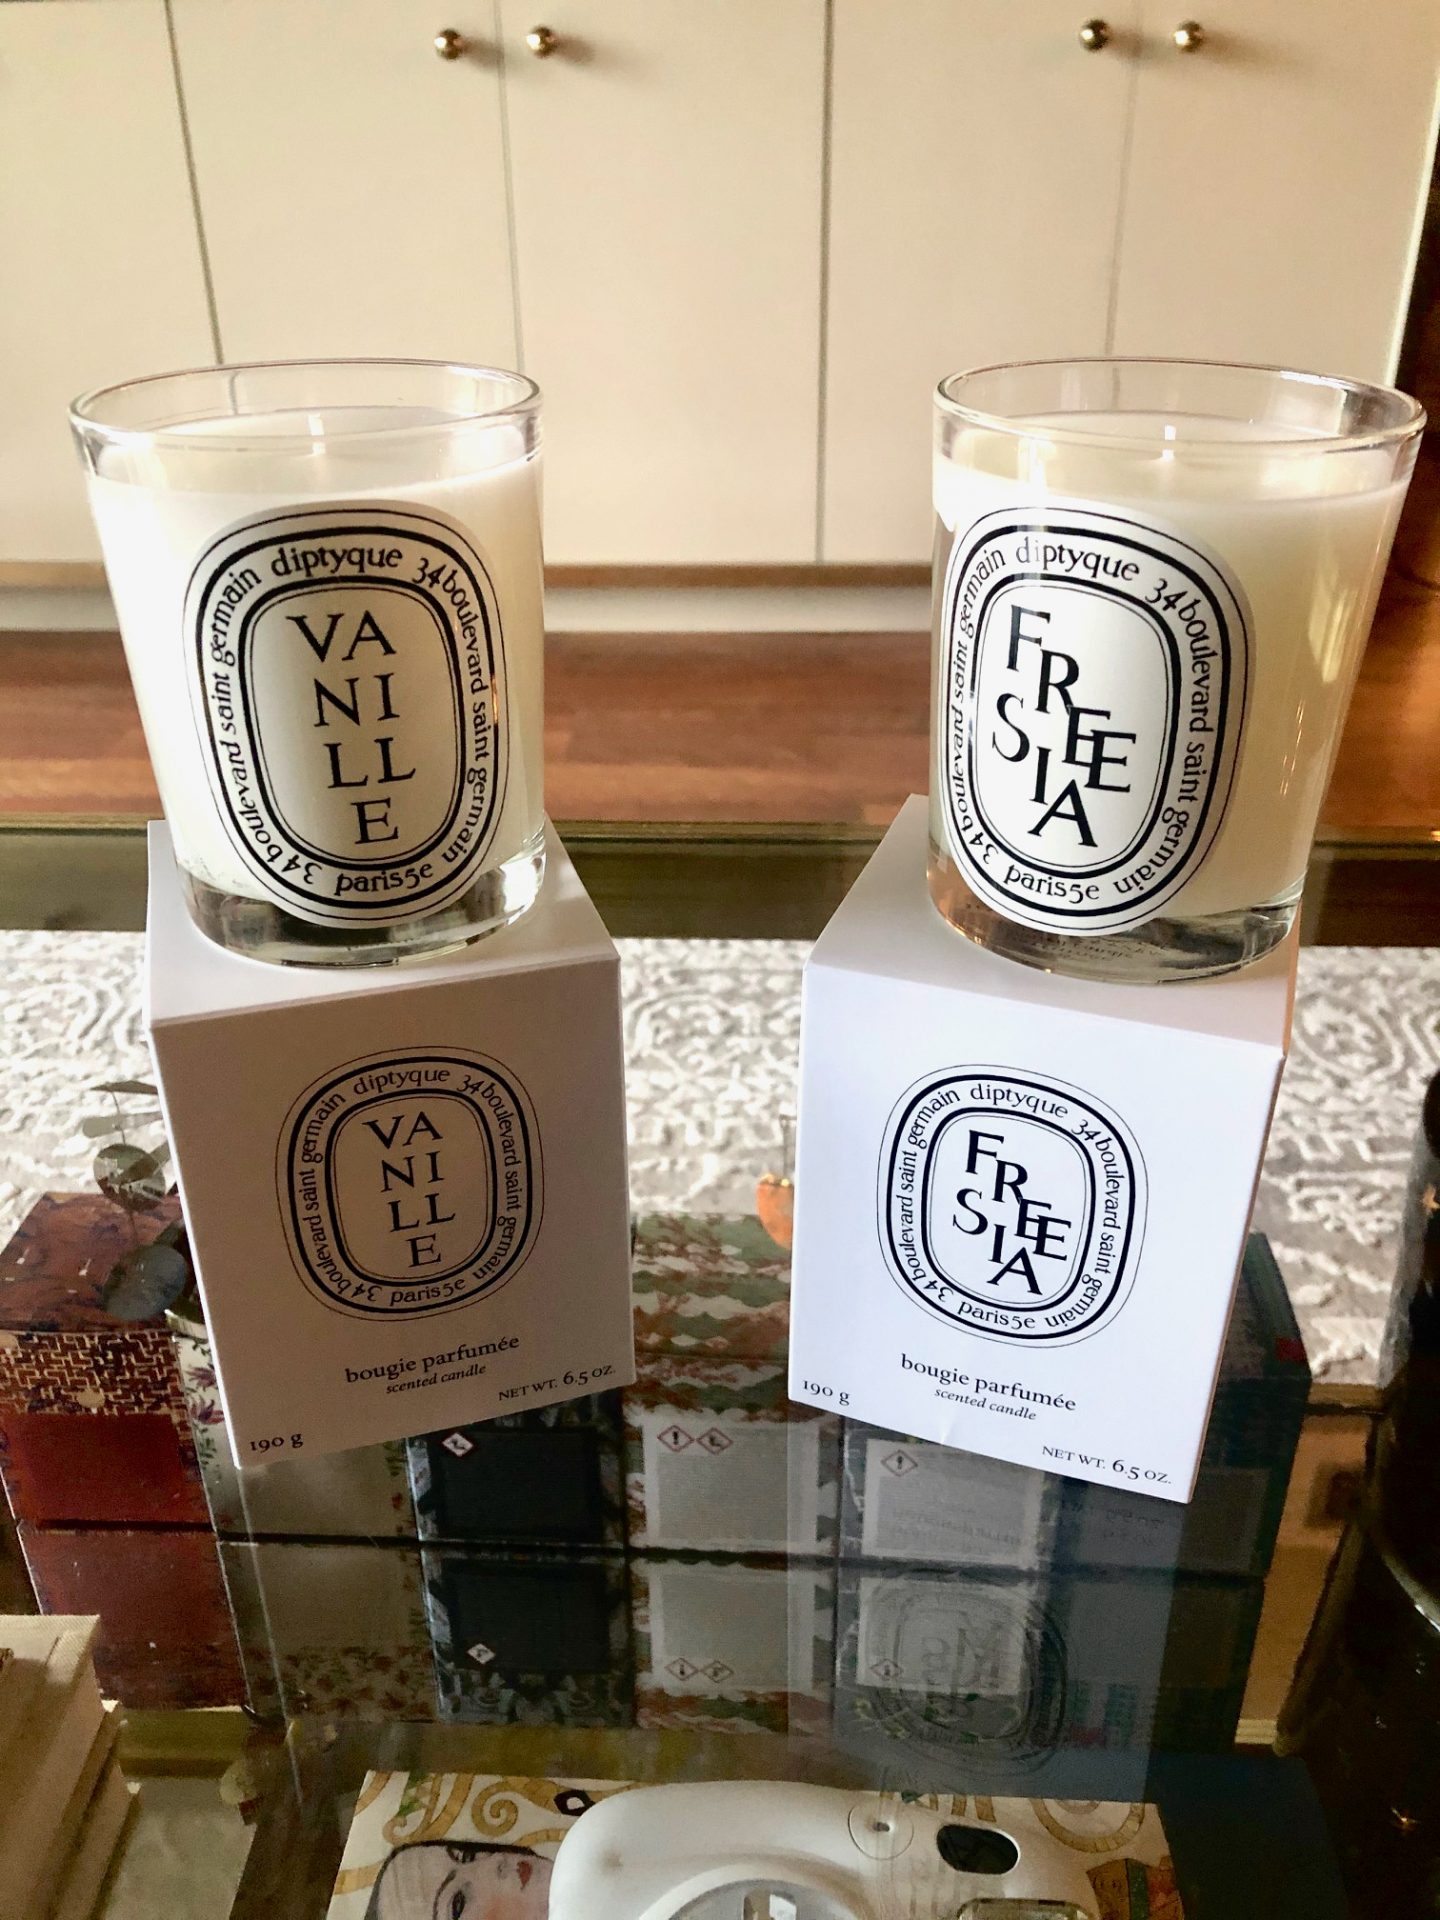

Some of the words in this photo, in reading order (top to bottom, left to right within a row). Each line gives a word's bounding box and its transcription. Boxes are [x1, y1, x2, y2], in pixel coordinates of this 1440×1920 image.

[271, 547, 402, 576] diptyque
[1016, 536, 1140, 581] diptyque
[960, 548, 1006, 638] germain
[210, 567, 262, 667] germain
[953, 639, 968, 702] saint
[210, 673, 236, 735] saint
[472, 702, 489, 762] saint
[1179, 741, 1205, 803] saint
[442, 767, 487, 864] germain
[1114, 806, 1190, 895] germain
[353, 1068, 450, 1096] diptyque
[970, 1083, 1068, 1118] diptyque
[302, 1093, 346, 1164] germain
[908, 1088, 960, 1149] germain
[299, 1170, 317, 1212] saint
[505, 1170, 520, 1209] saint
[899, 1151, 918, 1192] saint
[473, 1216, 517, 1281] germain
[1096, 1233, 1117, 1273] saint
[1044, 1273, 1103, 1330] germain
[346, 1357, 416, 1383] bougie
[422, 1335, 520, 1371] parfumée
[386, 1372, 437, 1395] scented
[441, 1363, 487, 1386] candle
[901, 1353, 969, 1387] bougie
[974, 1375, 1076, 1411] parfumée
[499, 1385, 531, 1401] NET
[563, 1369, 589, 1386] 6.5
[803, 1380, 833, 1397] 190
[839, 1391, 849, 1406] g
[935, 1388, 987, 1409] scented
[989, 1402, 1036, 1421] candle
[250, 1436, 284, 1453] 190
[290, 1433, 304, 1448] g
[1042, 1445, 1075, 1461] NET
[1112, 1459, 1139, 1479] 6.5
